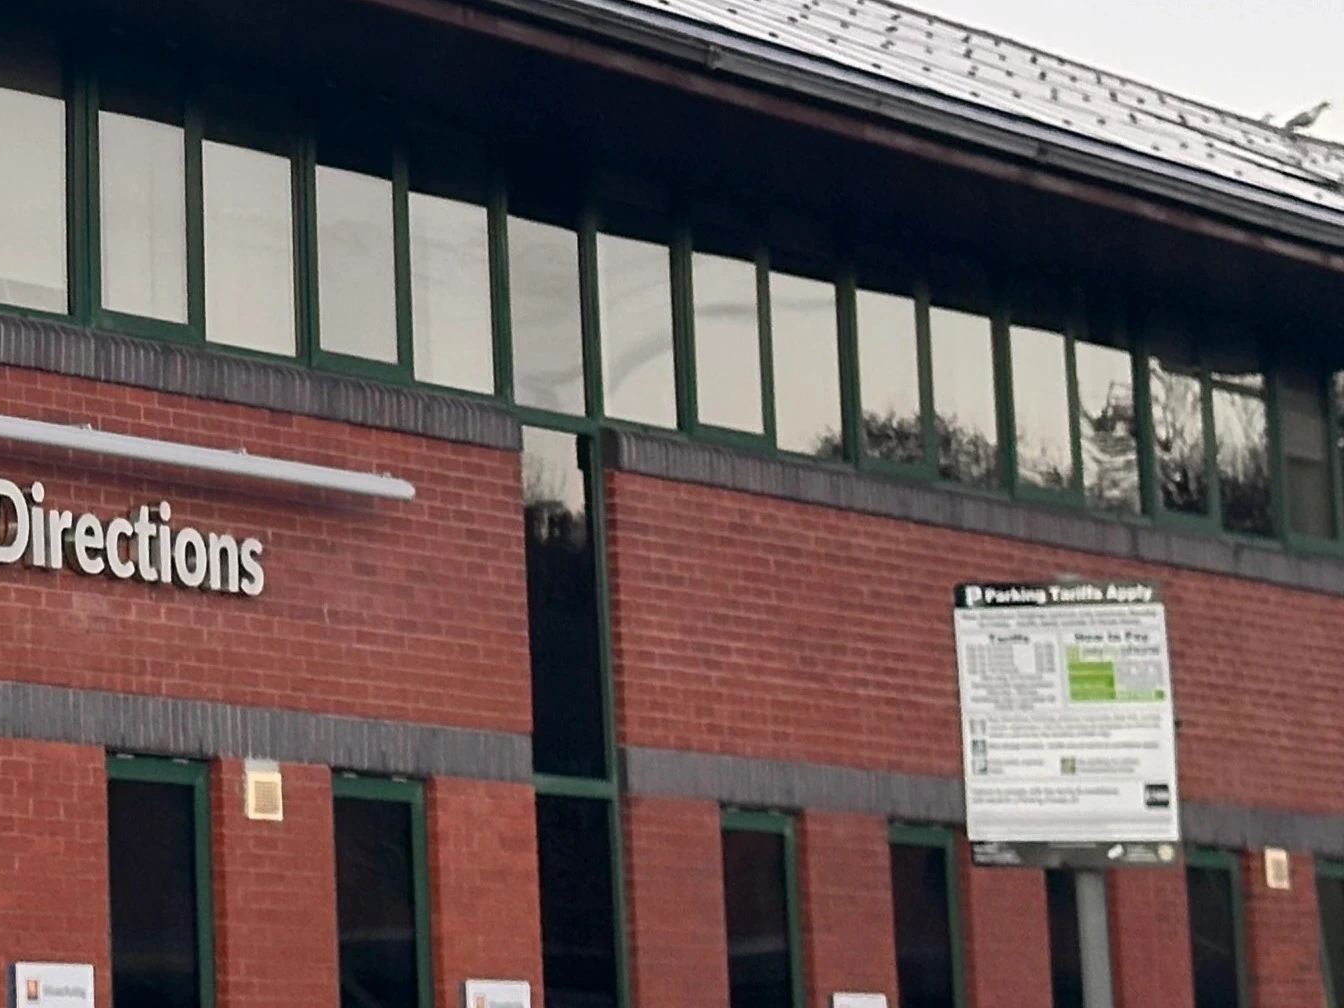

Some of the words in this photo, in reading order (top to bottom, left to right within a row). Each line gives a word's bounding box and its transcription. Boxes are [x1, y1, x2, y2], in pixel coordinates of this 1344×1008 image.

[985, 586, 1046, 605] Parking
[1049, 584, 1103, 602] Tariffs
[1106, 583, 1153, 602] Apply
